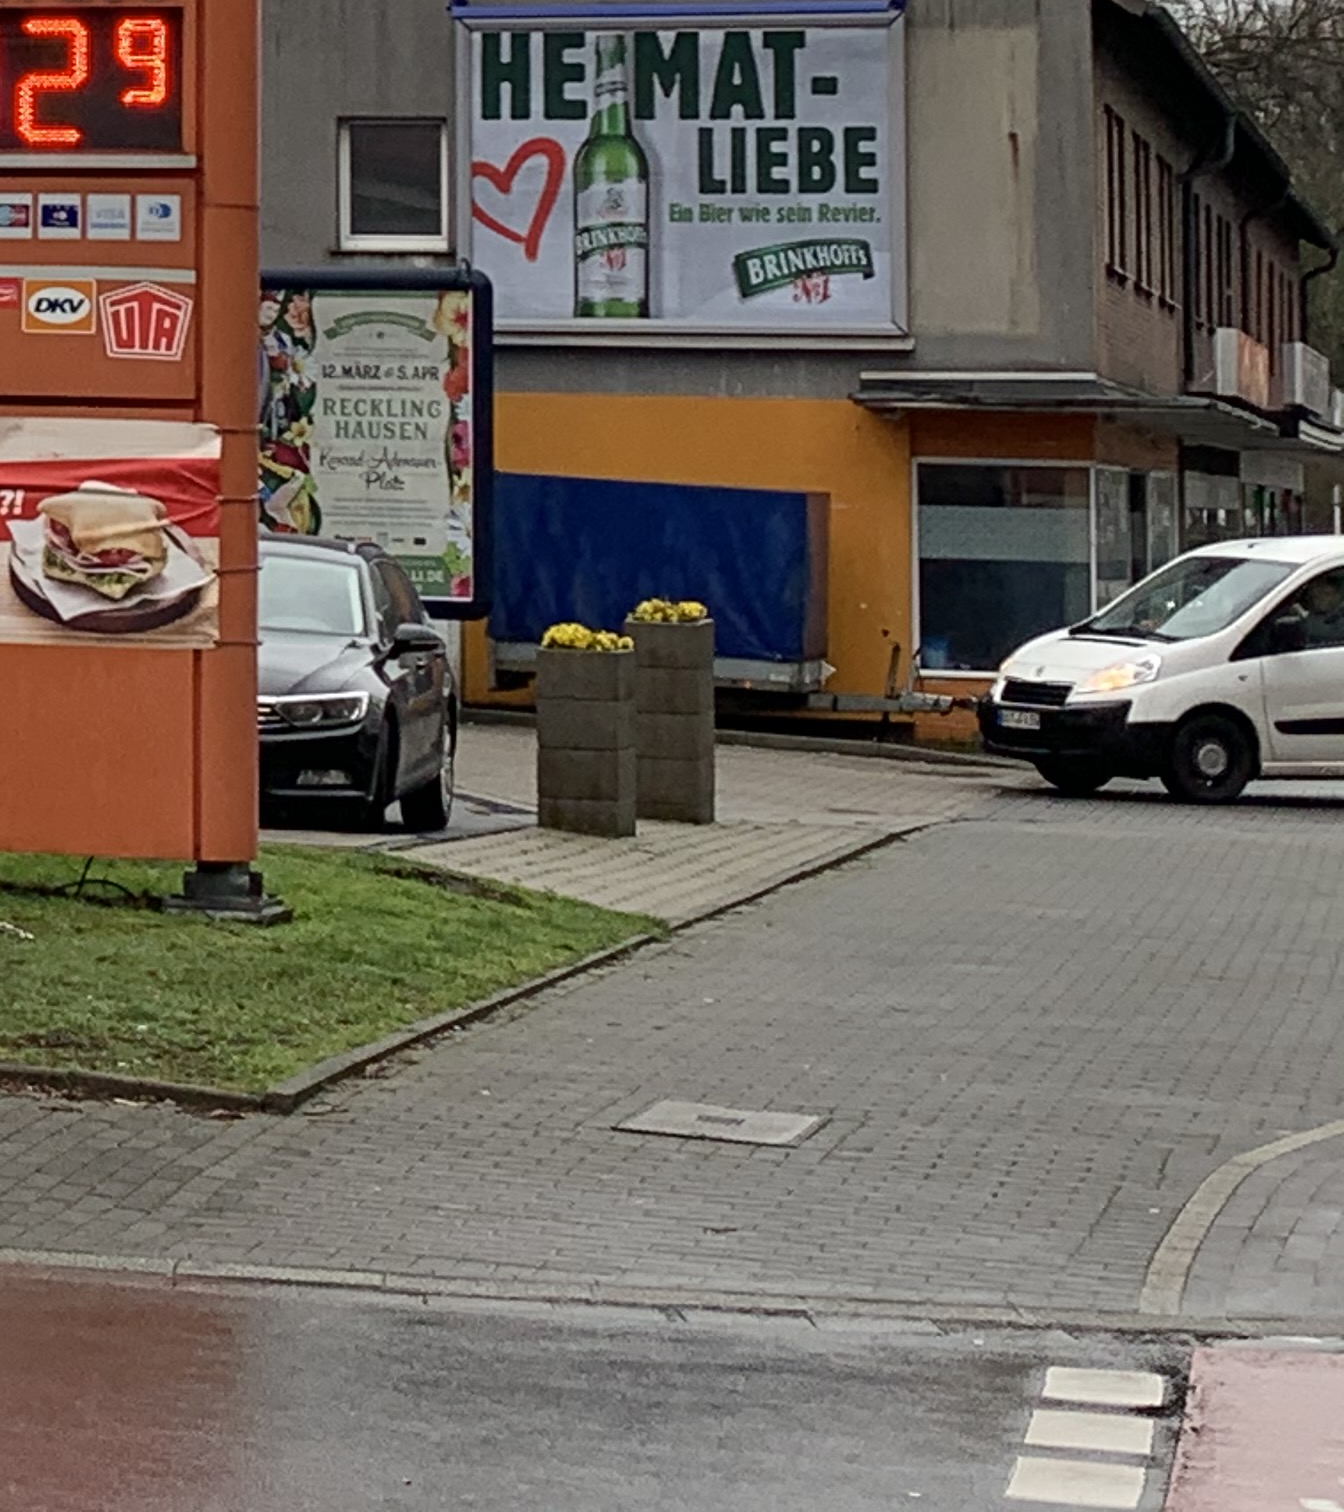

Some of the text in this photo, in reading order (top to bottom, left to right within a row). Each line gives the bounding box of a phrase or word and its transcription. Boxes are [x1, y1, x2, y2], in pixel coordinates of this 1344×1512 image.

[480, 30, 839, 121] HEMAT-
[697, 126, 880, 195] LIEBE
[669, 202, 882, 224] Ein Bier wie sein Revier.
[33, 297, 86, 314] DKV
[109, 288, 185, 352] UTA
[322, 397, 442, 419] RECKLING
[334, 420, 428, 440] HAUSEN
